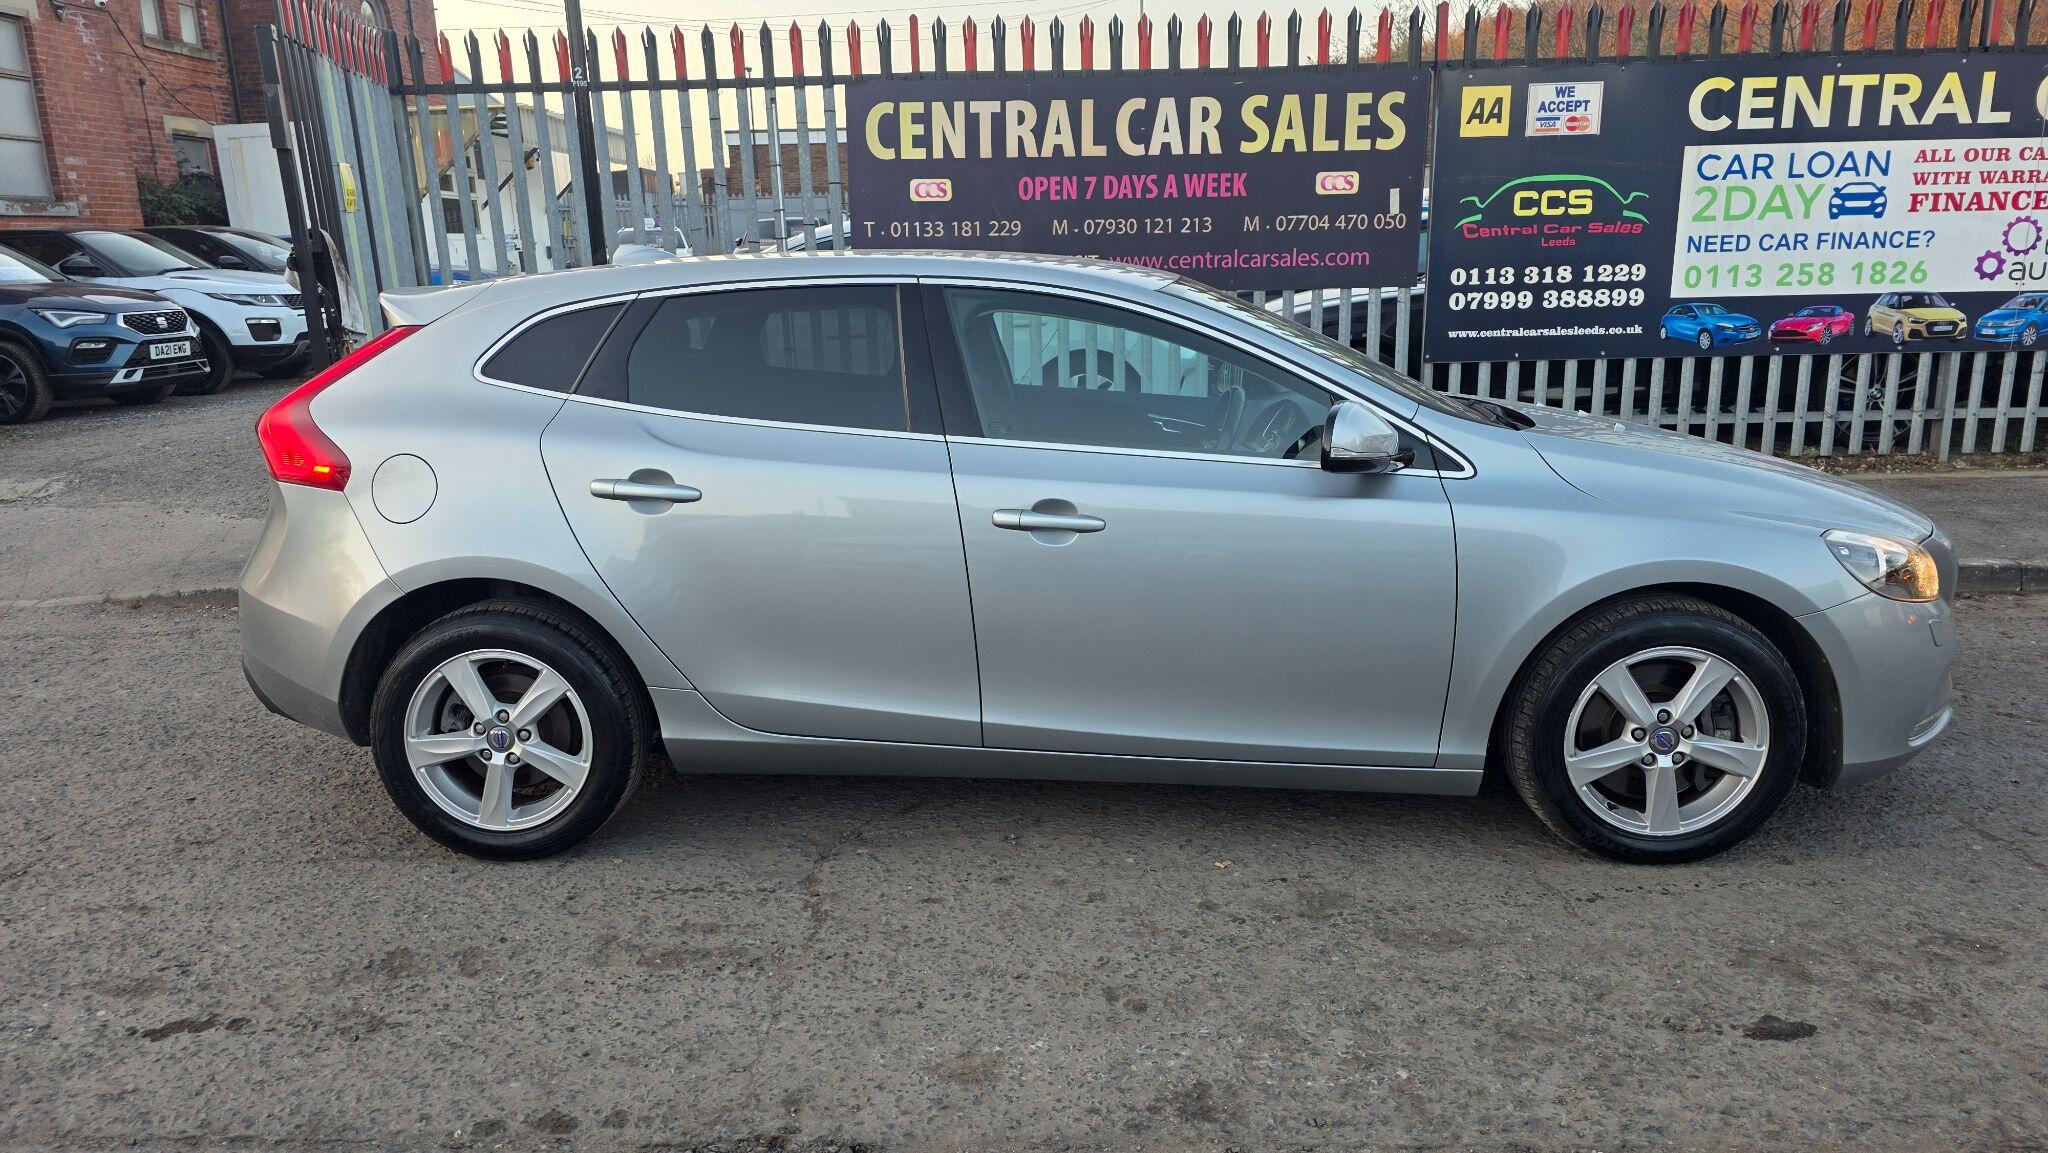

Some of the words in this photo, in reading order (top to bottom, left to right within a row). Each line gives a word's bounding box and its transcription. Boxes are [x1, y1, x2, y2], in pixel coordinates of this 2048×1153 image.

[574, 66, 582, 79] 2
[1555, 86, 1575, 98] WE
[1688, 71, 2011, 132] CENTRAL
[1466, 97, 1504, 125] AA
[1538, 100, 1590, 113] ACCEPT
[865, 98, 1107, 160] CENTRAL
[1116, 96, 1222, 156] CAR
[1240, 91, 1406, 153] SALES
[1914, 149, 1955, 163] ALL
[1964, 147, 2011, 162] OUR
[1697, 153, 1774, 181] CAR
[1788, 150, 1891, 179] LOAN
[1018, 176, 1078, 200] OPEN
[1085, 176, 1097, 200] 7
[1104, 173, 1158, 200] DAYS
[1164, 173, 1178, 198] A
[1184, 172, 1247, 198] WEEK
[1320, 175, 1354, 191] CCS
[1913, 171, 1971, 185] WITH
[914, 182, 948, 199] CCS
[1513, 189, 1593, 217] CCS
[1691, 183, 1826, 222] 2DAY
[1908, 190, 2048, 212] FINANCE
[863, 221, 875, 237] T
[890, 221, 944, 238] 01133
[951, 220, 981, 237] 181
[988, 220, 1022, 237] 229
[1052, 219, 1068, 235] M
[1084, 217, 1137, 235] 07930
[1144, 218, 1172, 234] 121
[1181, 217, 1212, 233] 213
[1243, 215, 1260, 232] M
[1275, 214, 1330, 231] 07704
[1335, 213, 1368, 230] 470
[1374, 212, 1407, 229] 050
[1462, 223, 1538, 239] Central
[1543, 223, 1582, 234] Car
[1587, 221, 1643, 234] Sales
[1541, 237, 1576, 247] Leeds
[1687, 234, 1750, 253] NEED
[1758, 232, 1808, 251] CAR
[1816, 230, 1936, 250] FINANCE?
[1450, 267, 1515, 286] 0113
[1523, 265, 1573, 284] 318
[1583, 263, 1646, 283] 1229
[1684, 263, 1763, 289] 0113
[1775, 262, 1835, 287] 258
[1850, 260, 1928, 285] 1826
[1449, 291, 1533, 311] 07999
[1542, 288, 1645, 309] 388899
[1448, 325, 1642, 338] www.centralcarsalesleeds.co.uk
[155, 344, 172, 357] DA21
[173, 343, 187, 355] EWG
